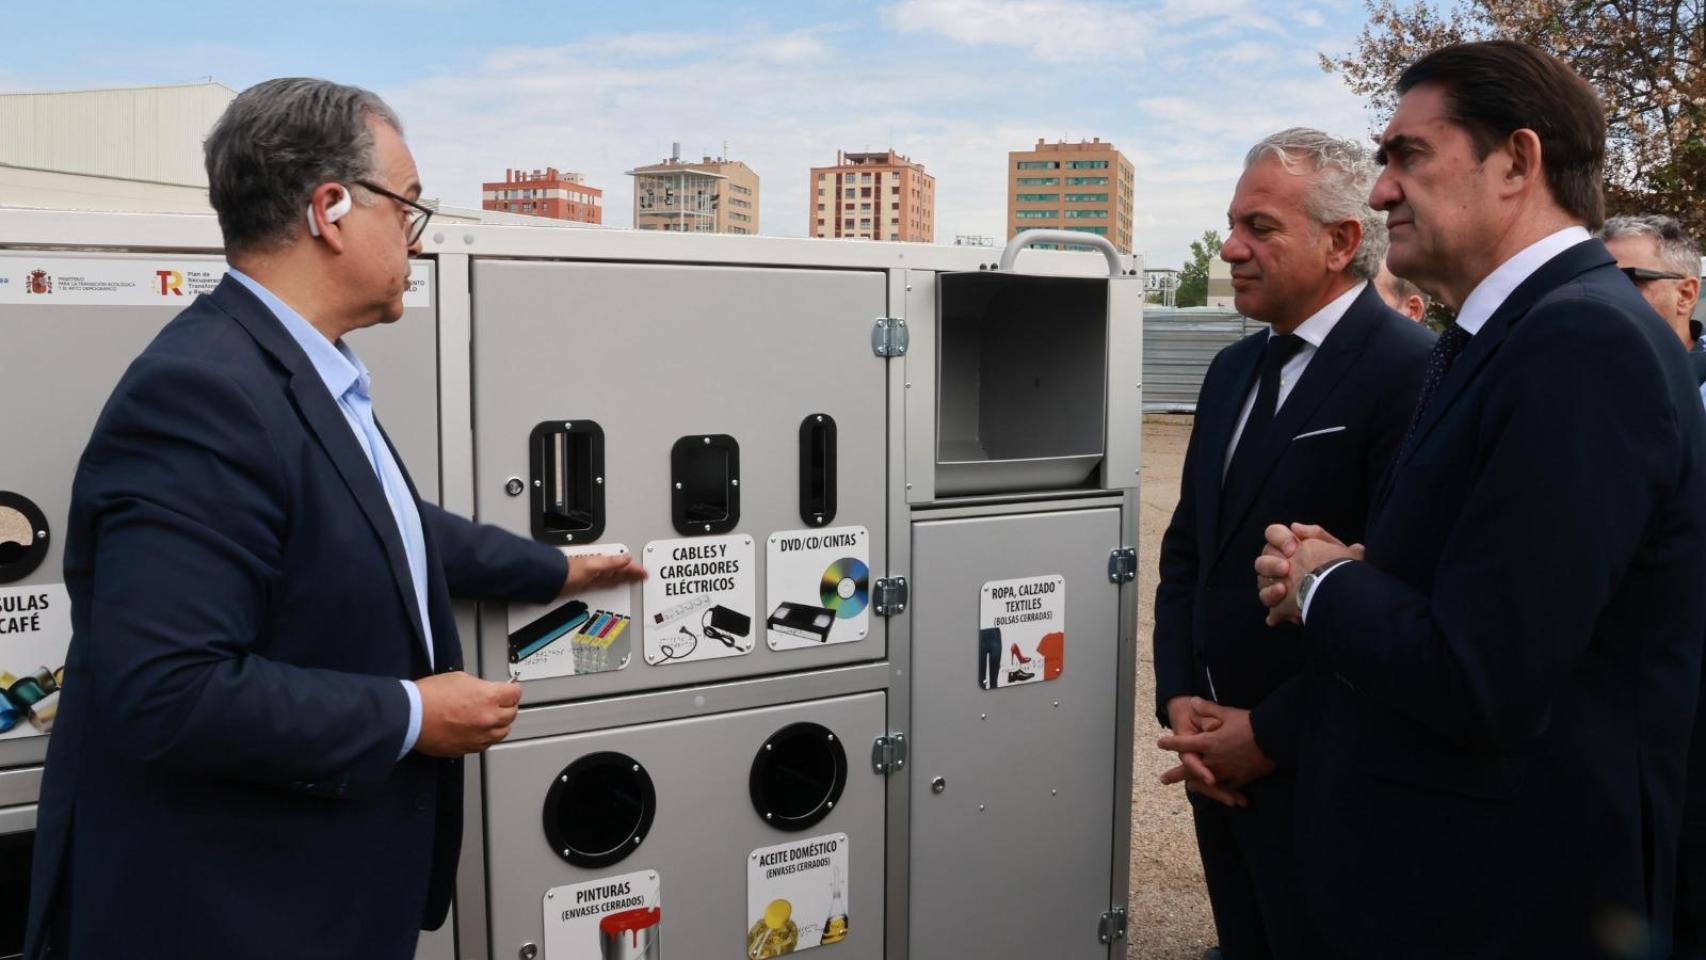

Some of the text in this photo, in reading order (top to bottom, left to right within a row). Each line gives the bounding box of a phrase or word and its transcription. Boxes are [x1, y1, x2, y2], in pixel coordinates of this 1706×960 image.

[781, 533, 856, 552] DVD/CD/CINTAS
[673, 544, 727, 561] CABLES Y
[660, 560, 739, 579] CARGADORES
[666, 577, 735, 596] ELÉCTRICOS
[992, 582, 1055, 599] ROPA, CALZADO
[1005, 597, 1041, 613] TEXTILES
[994, 611, 1052, 626] (BOLSAS CERRADAS)
[759, 840, 837, 867] ACEITE DOMÉSTICO
[766, 857, 831, 879] (ENVASES CERRADOS)
[577, 882, 631, 904] PINTURAS
[561, 895, 645, 922] (ENVASES CERRADOS)
